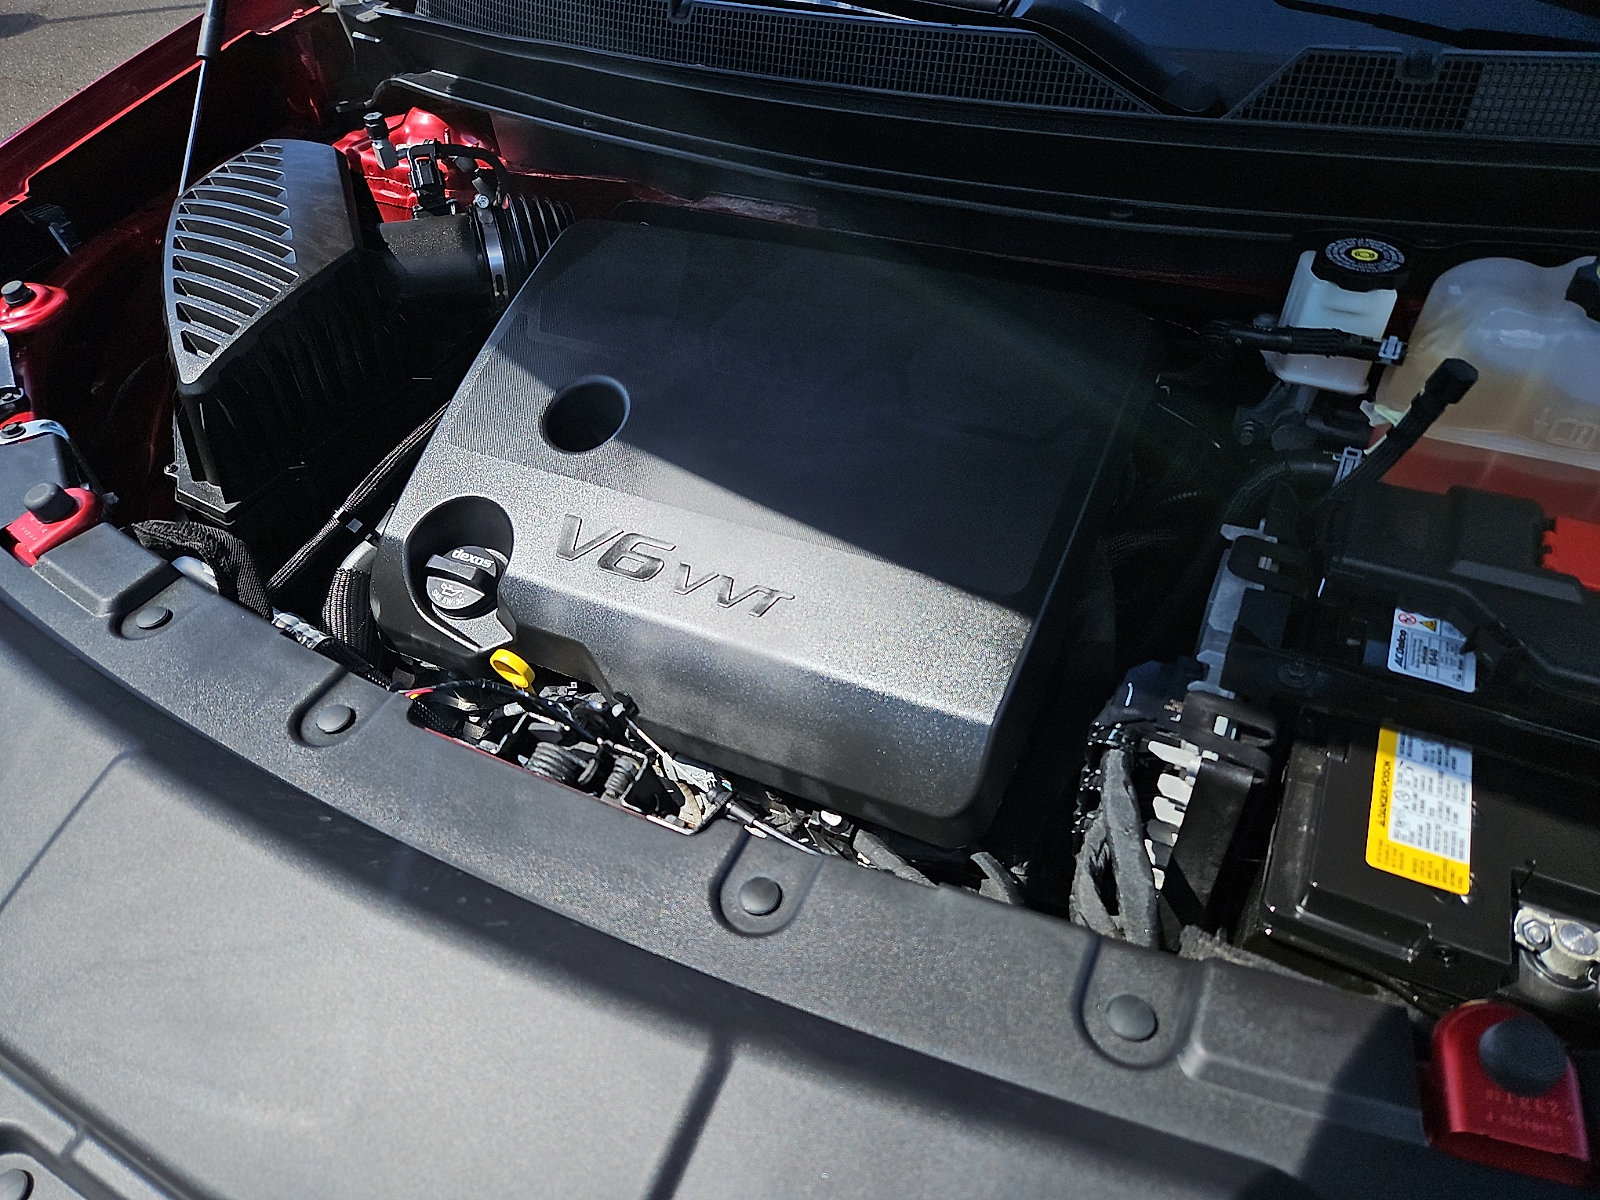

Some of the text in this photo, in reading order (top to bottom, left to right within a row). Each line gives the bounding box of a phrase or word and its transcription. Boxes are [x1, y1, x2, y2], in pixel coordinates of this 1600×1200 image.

[451, 548, 495, 569] dexos
[556, 513, 796, 618] V6 VVT
